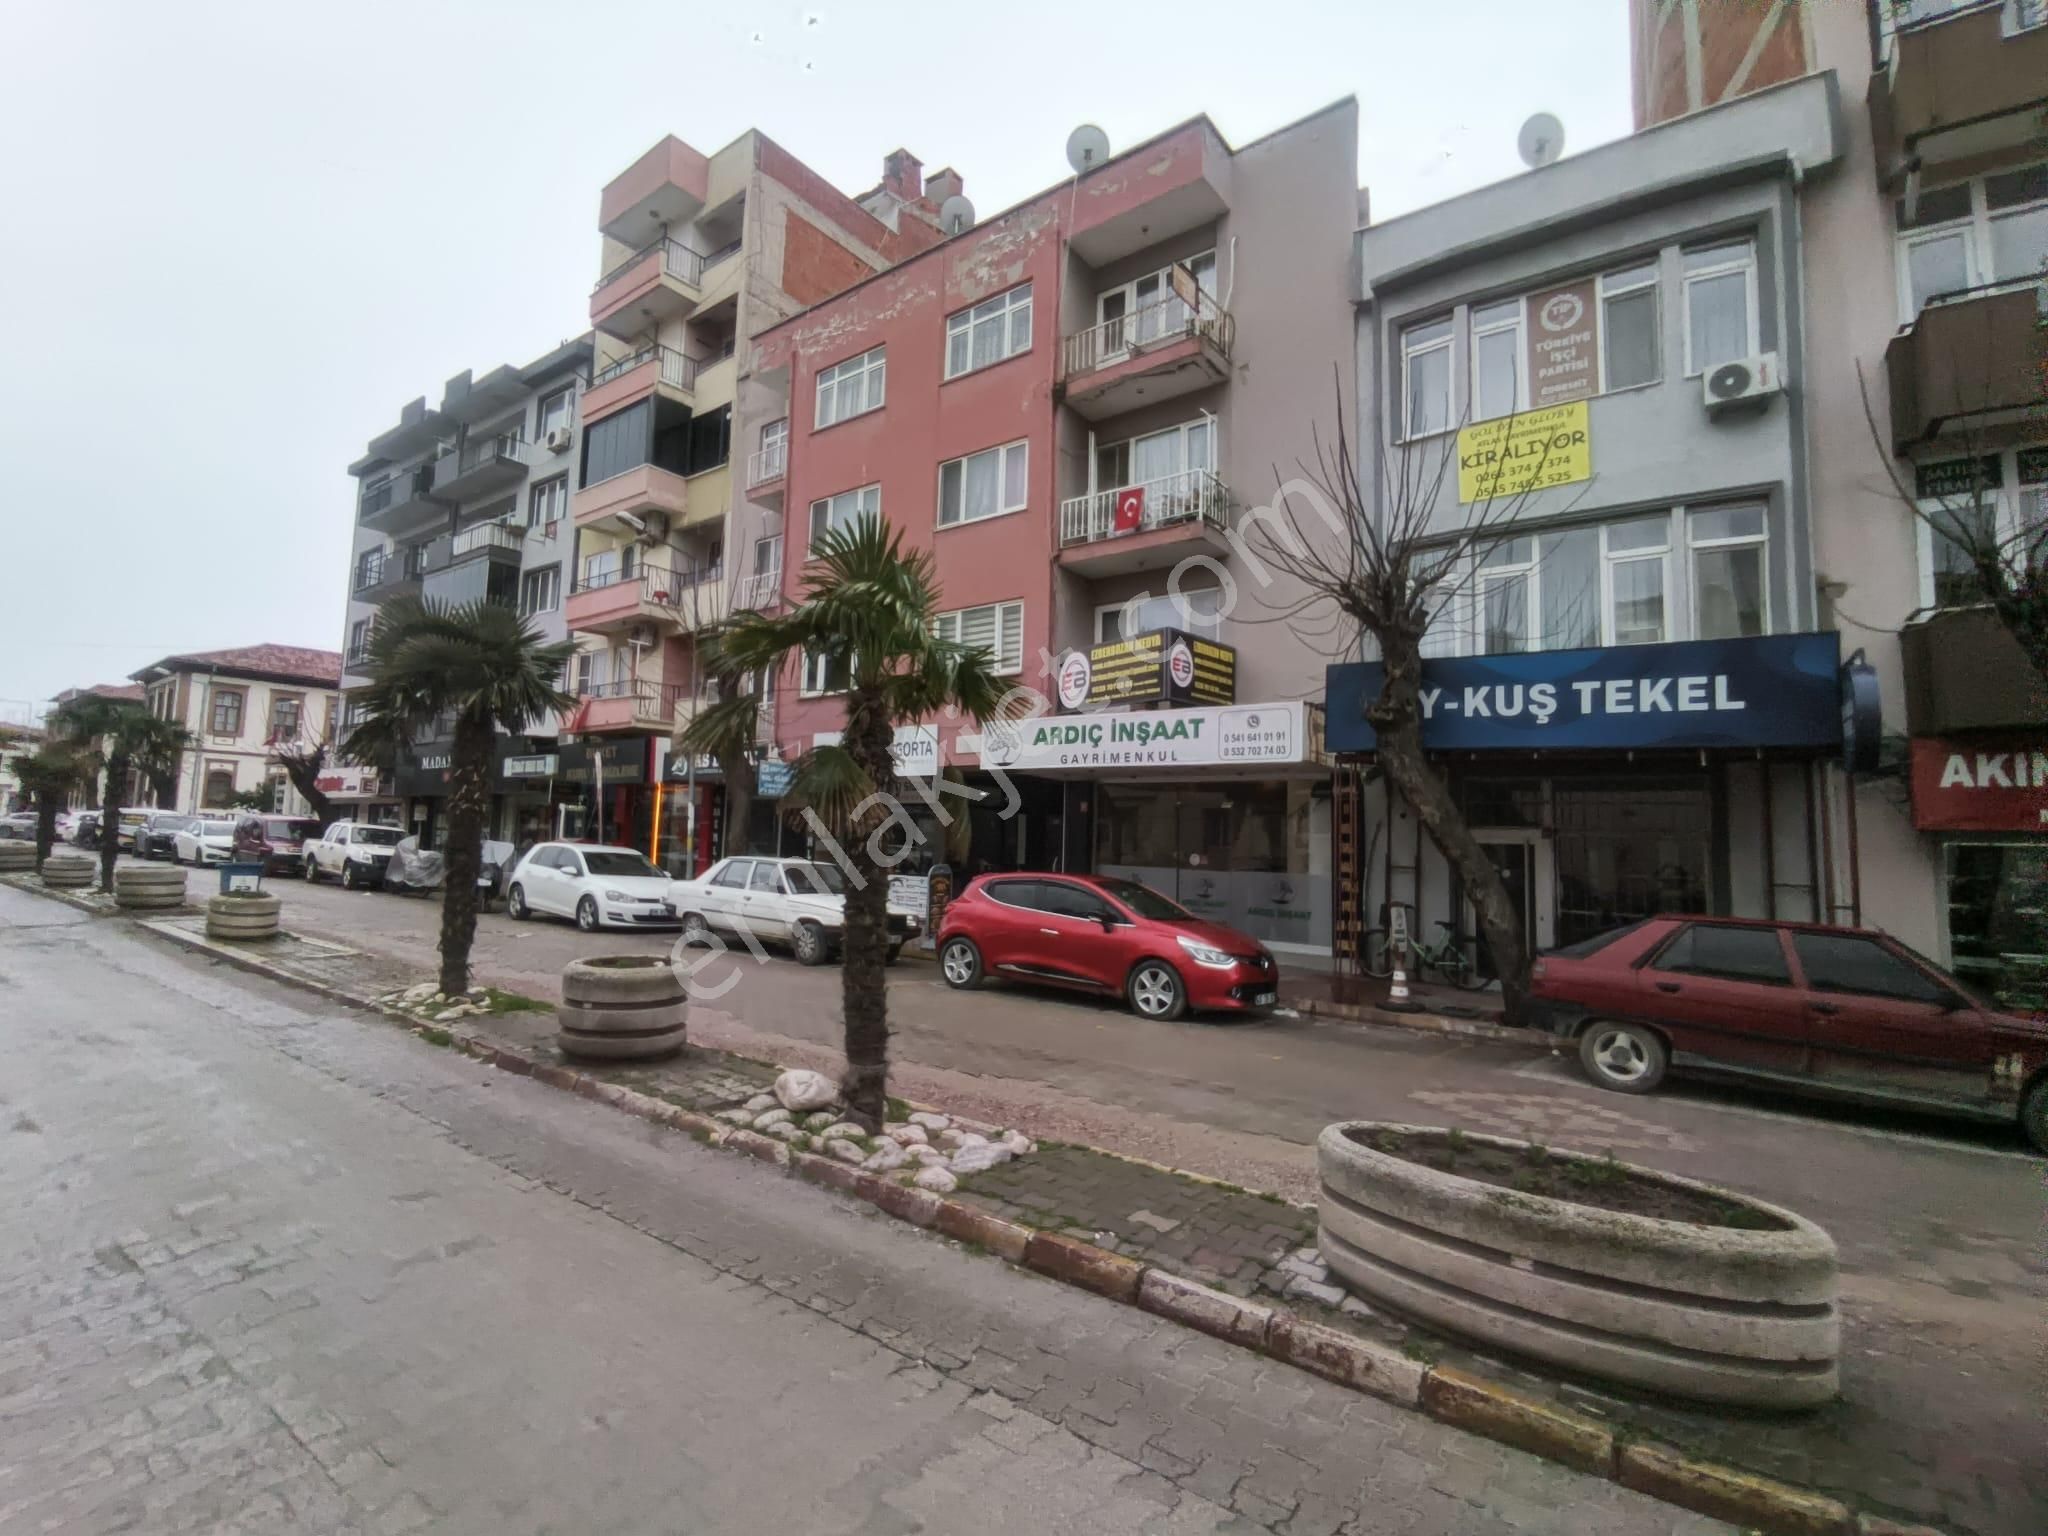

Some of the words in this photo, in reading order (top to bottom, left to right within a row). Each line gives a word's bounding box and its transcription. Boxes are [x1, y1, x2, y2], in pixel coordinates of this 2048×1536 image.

[1461, 430, 1585, 470] KİRALIYOR
[1510, 463, 1532, 477] 374
[1173, 656, 1191, 675] EB
[1062, 670, 1087, 692] EB
[1418, 683, 1557, 724] Y-KUŞ
[1572, 675, 1746, 716] TEKEL
[1033, 724, 1103, 748] ARDIÇ
[1110, 718, 1205, 746] İNŞAAT
[1223, 733, 1230, 743] 0
[1231, 733, 1245, 743] 541
[1247, 732, 1262, 742] 641
[1263, 731, 1274, 741] 01
[1275, 731, 1286, 741] 91
[1060, 751, 1178, 765] GAYRİMENKUL
[1223, 747, 1230, 757] 0
[1231, 746, 1246, 756] 532
[1247, 746, 1262, 756] 702
[1263, 745, 1274, 755] 74
[1275, 745, 1286, 755] 03
